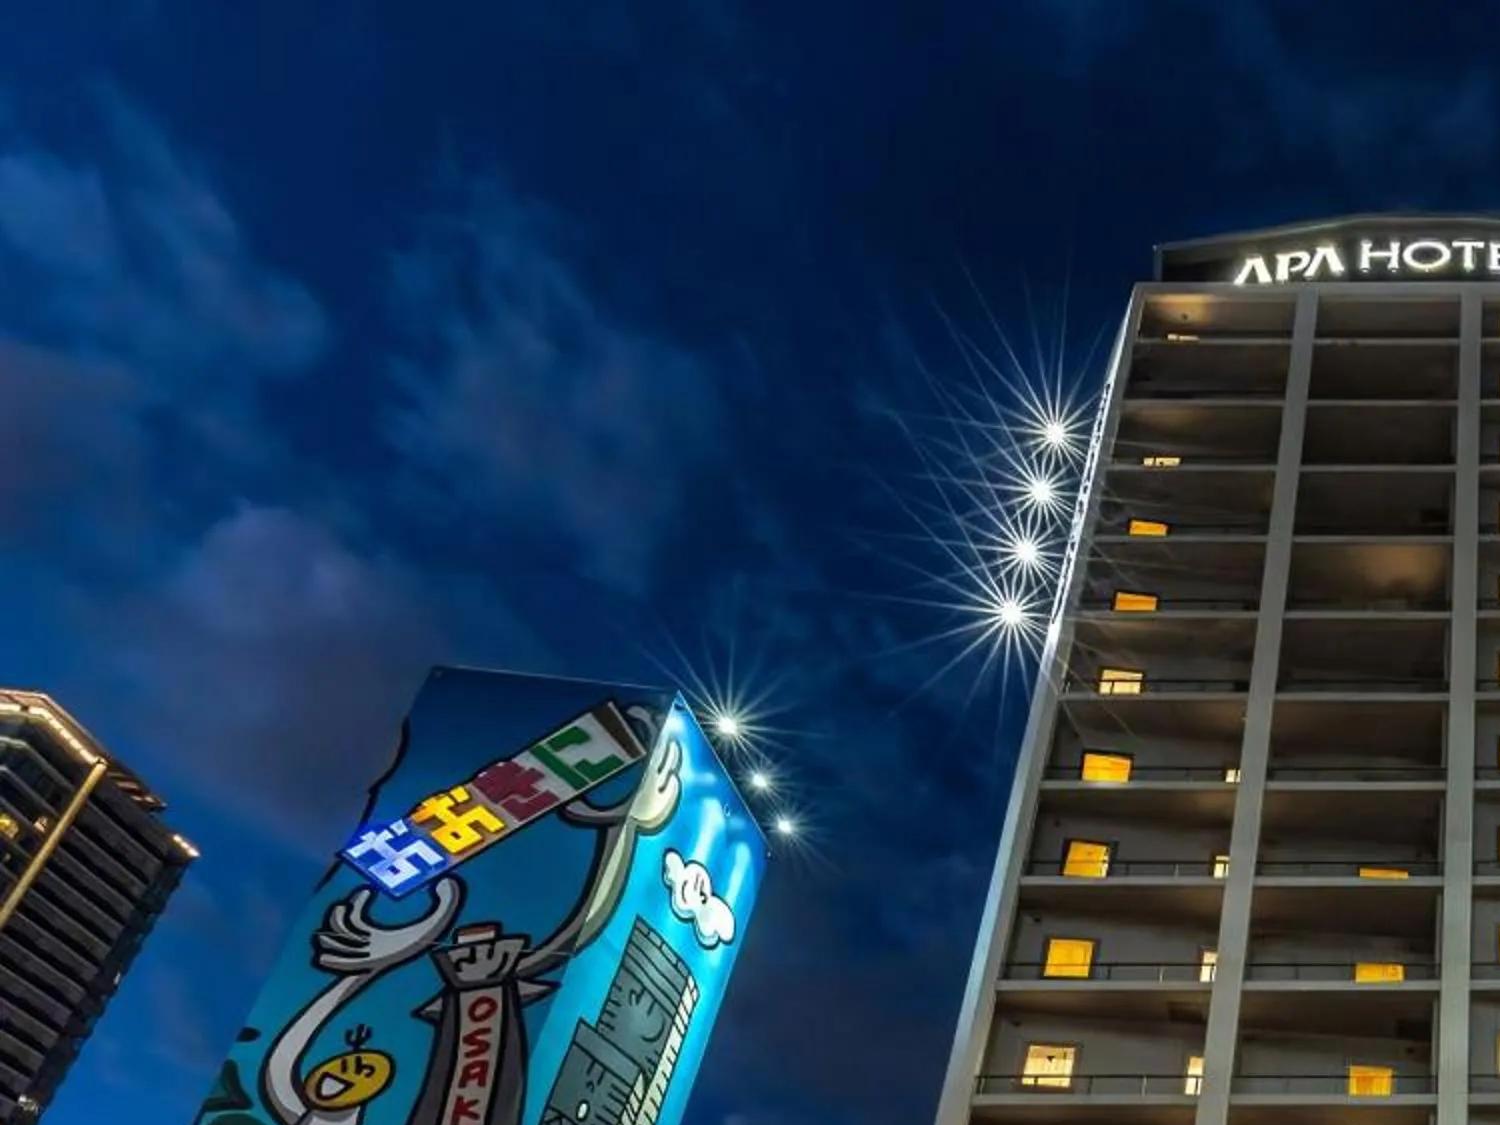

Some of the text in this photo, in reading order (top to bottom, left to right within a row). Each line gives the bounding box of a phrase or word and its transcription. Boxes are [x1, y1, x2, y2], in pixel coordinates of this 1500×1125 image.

[1233, 245, 1346, 286] APA
[345, 725, 625, 889] おおきに
